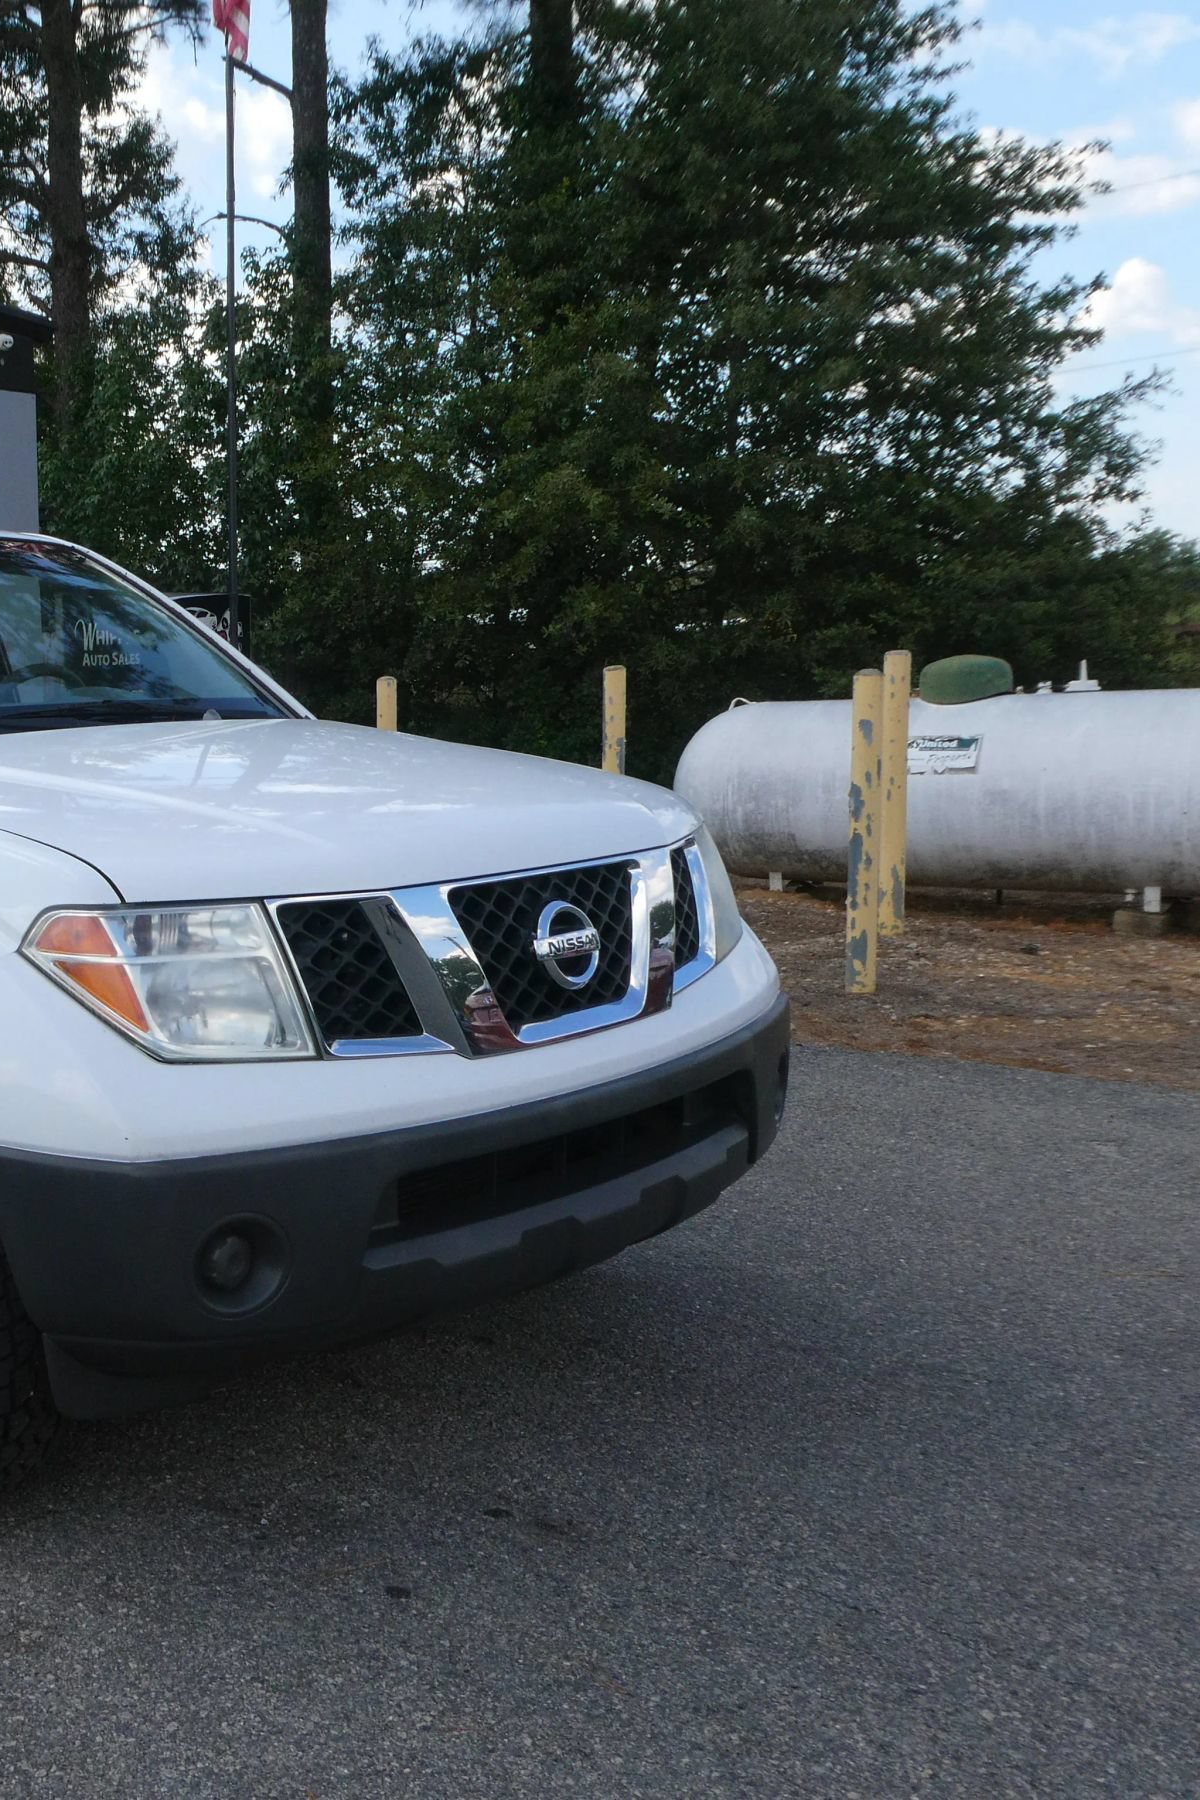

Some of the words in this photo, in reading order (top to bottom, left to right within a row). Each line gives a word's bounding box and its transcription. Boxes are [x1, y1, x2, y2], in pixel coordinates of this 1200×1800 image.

[82, 652, 110, 667] AUTO
[111, 651, 141, 666] SALES
[548, 932, 600, 955] NISSAN
